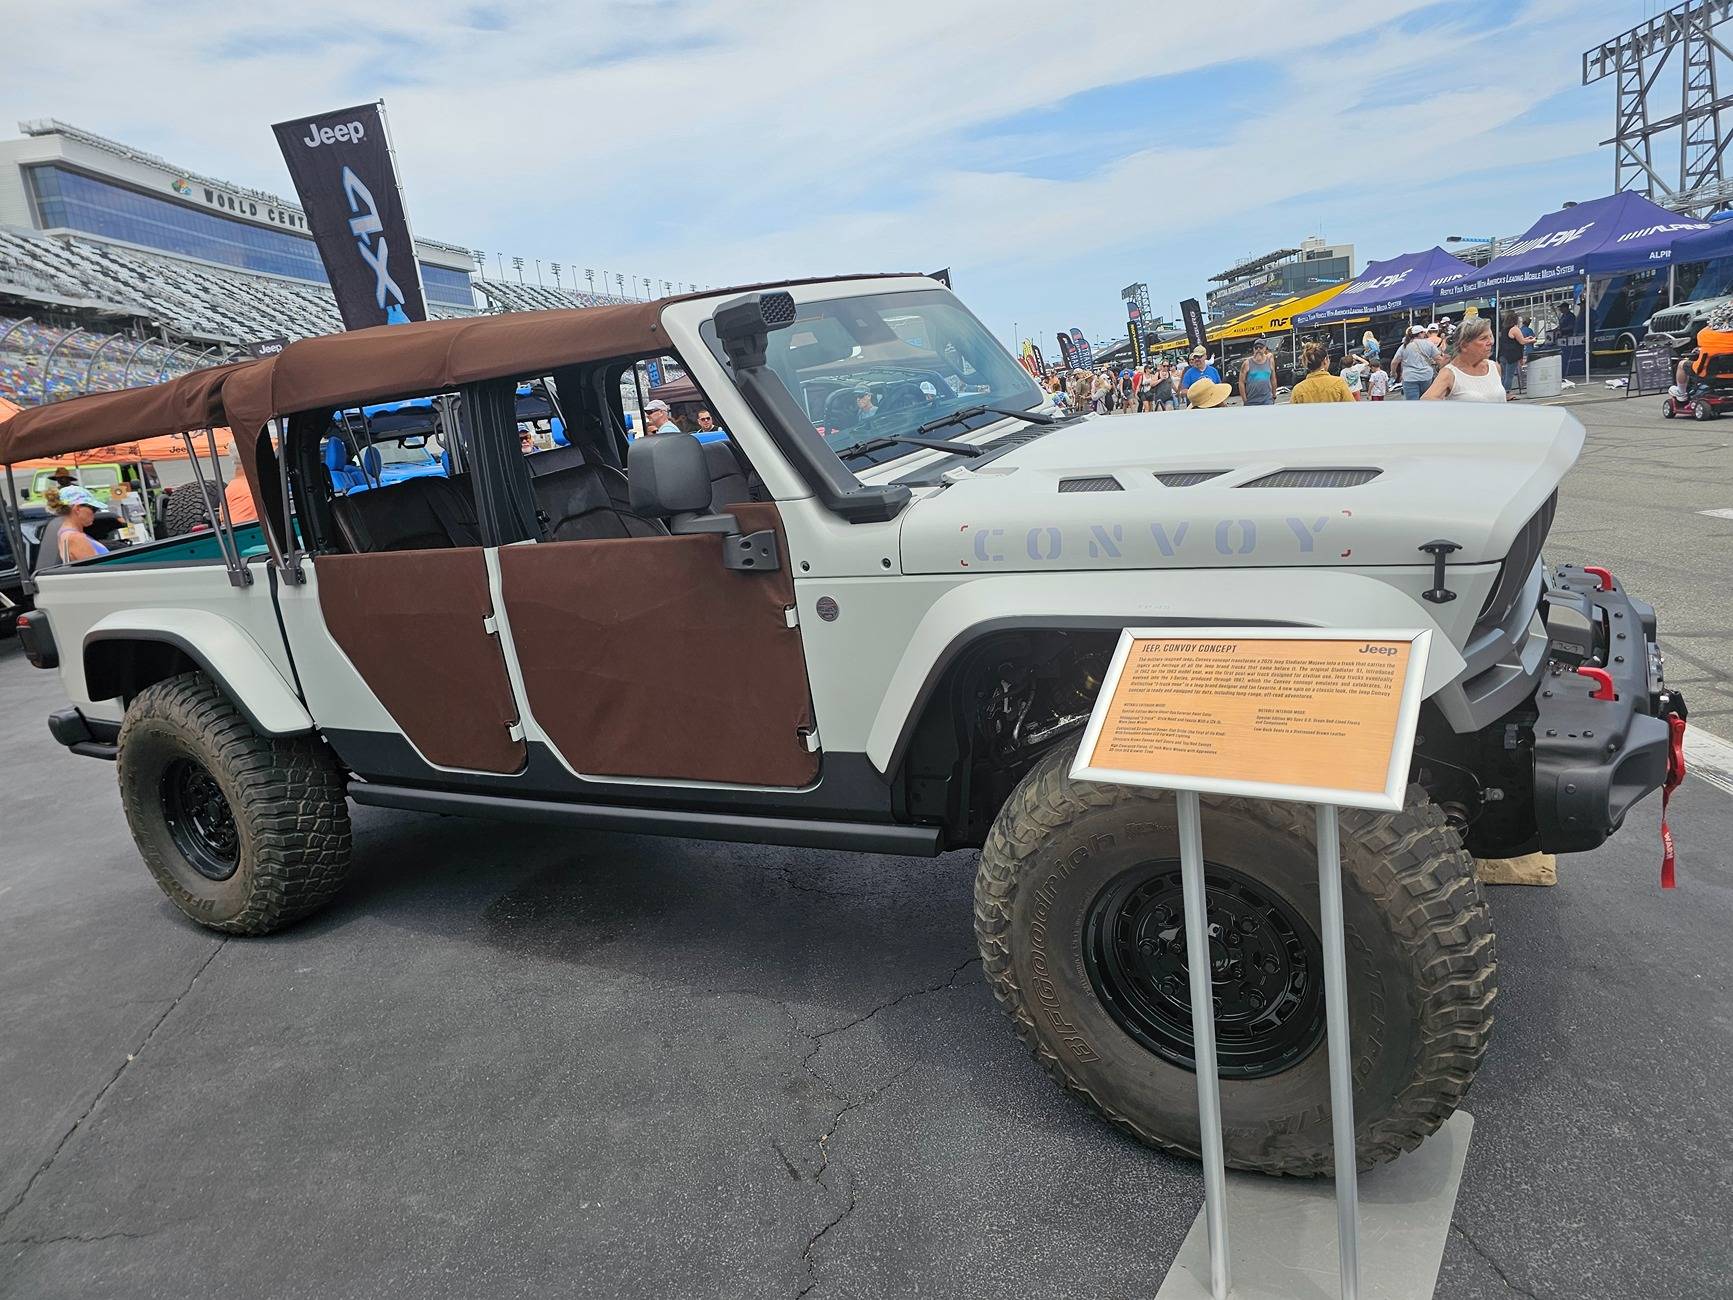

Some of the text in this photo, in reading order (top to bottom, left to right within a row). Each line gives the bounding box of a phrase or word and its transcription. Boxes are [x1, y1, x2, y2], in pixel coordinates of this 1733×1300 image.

[304, 120, 364, 148] Jeep
[203, 188, 310, 231] WORLD CENT
[259, 344, 283, 354] Jeep
[169, 446, 187, 454] Jee
[974, 516, 1330, 562] CONVOY
[1163, 643, 1196, 652] CONVOY
[1198, 644, 1237, 653] CONCEPT
[1358, 643, 1398, 656] Jeep
